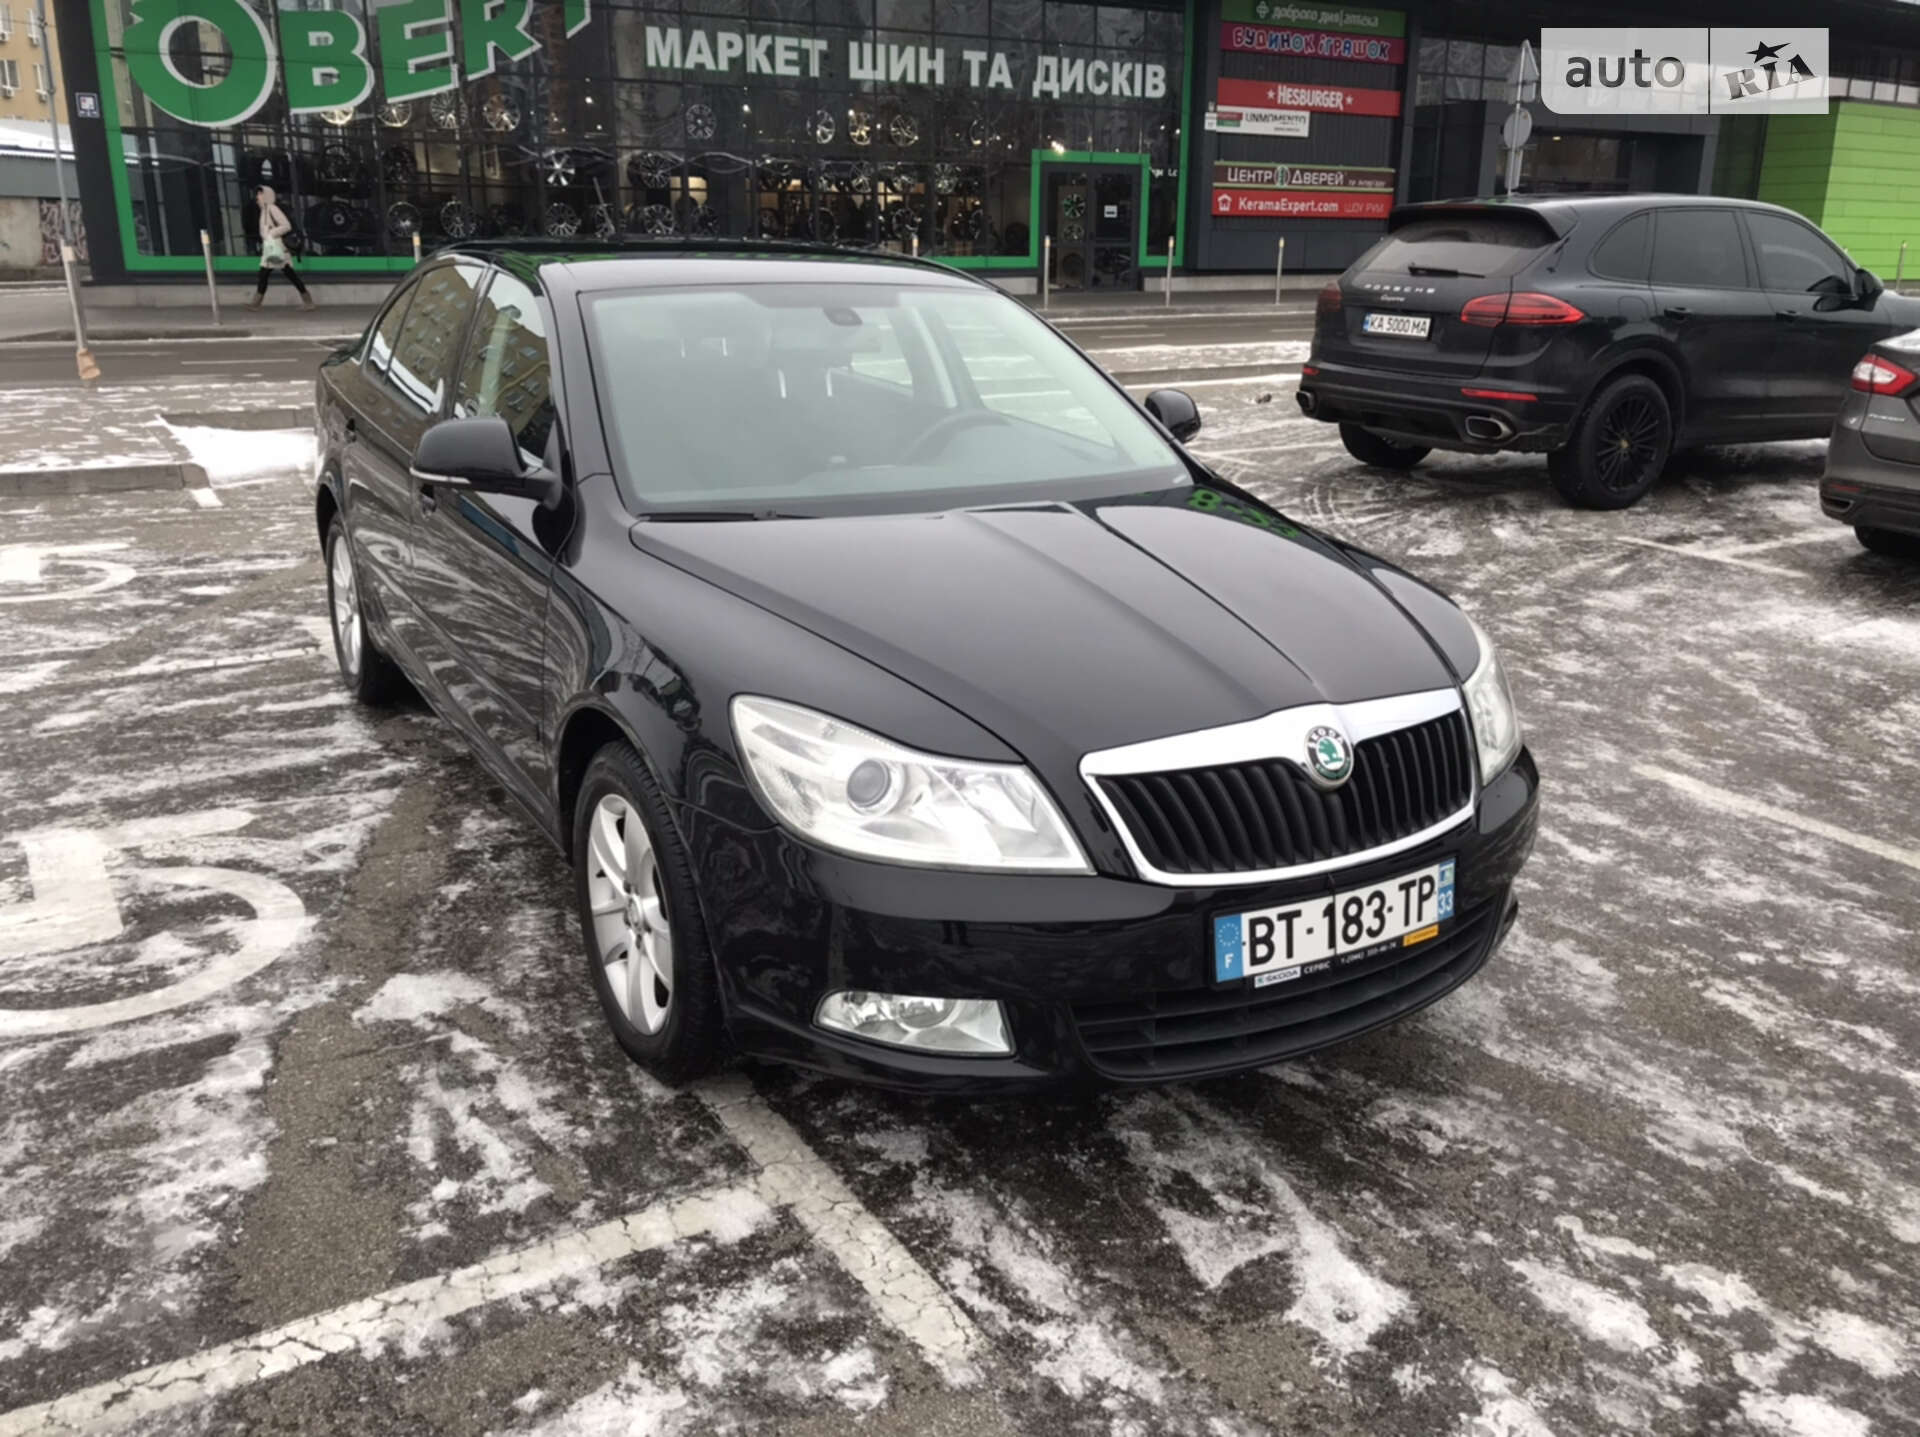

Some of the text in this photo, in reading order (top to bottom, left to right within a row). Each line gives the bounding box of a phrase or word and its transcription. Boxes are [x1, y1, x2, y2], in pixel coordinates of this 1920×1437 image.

[645, 26, 1167, 99] МАРКЕТ ШИН ТА ДИСКІВ
[1227, 168, 1272, 183] ЦЕНТР
[1292, 169, 1344, 185] ДВЕРЕЙ
[1239, 197, 1339, 214] KeramaExpert.com
[1438, 890, 1454, 915] 33
[1223, 953, 1234, 969] F
